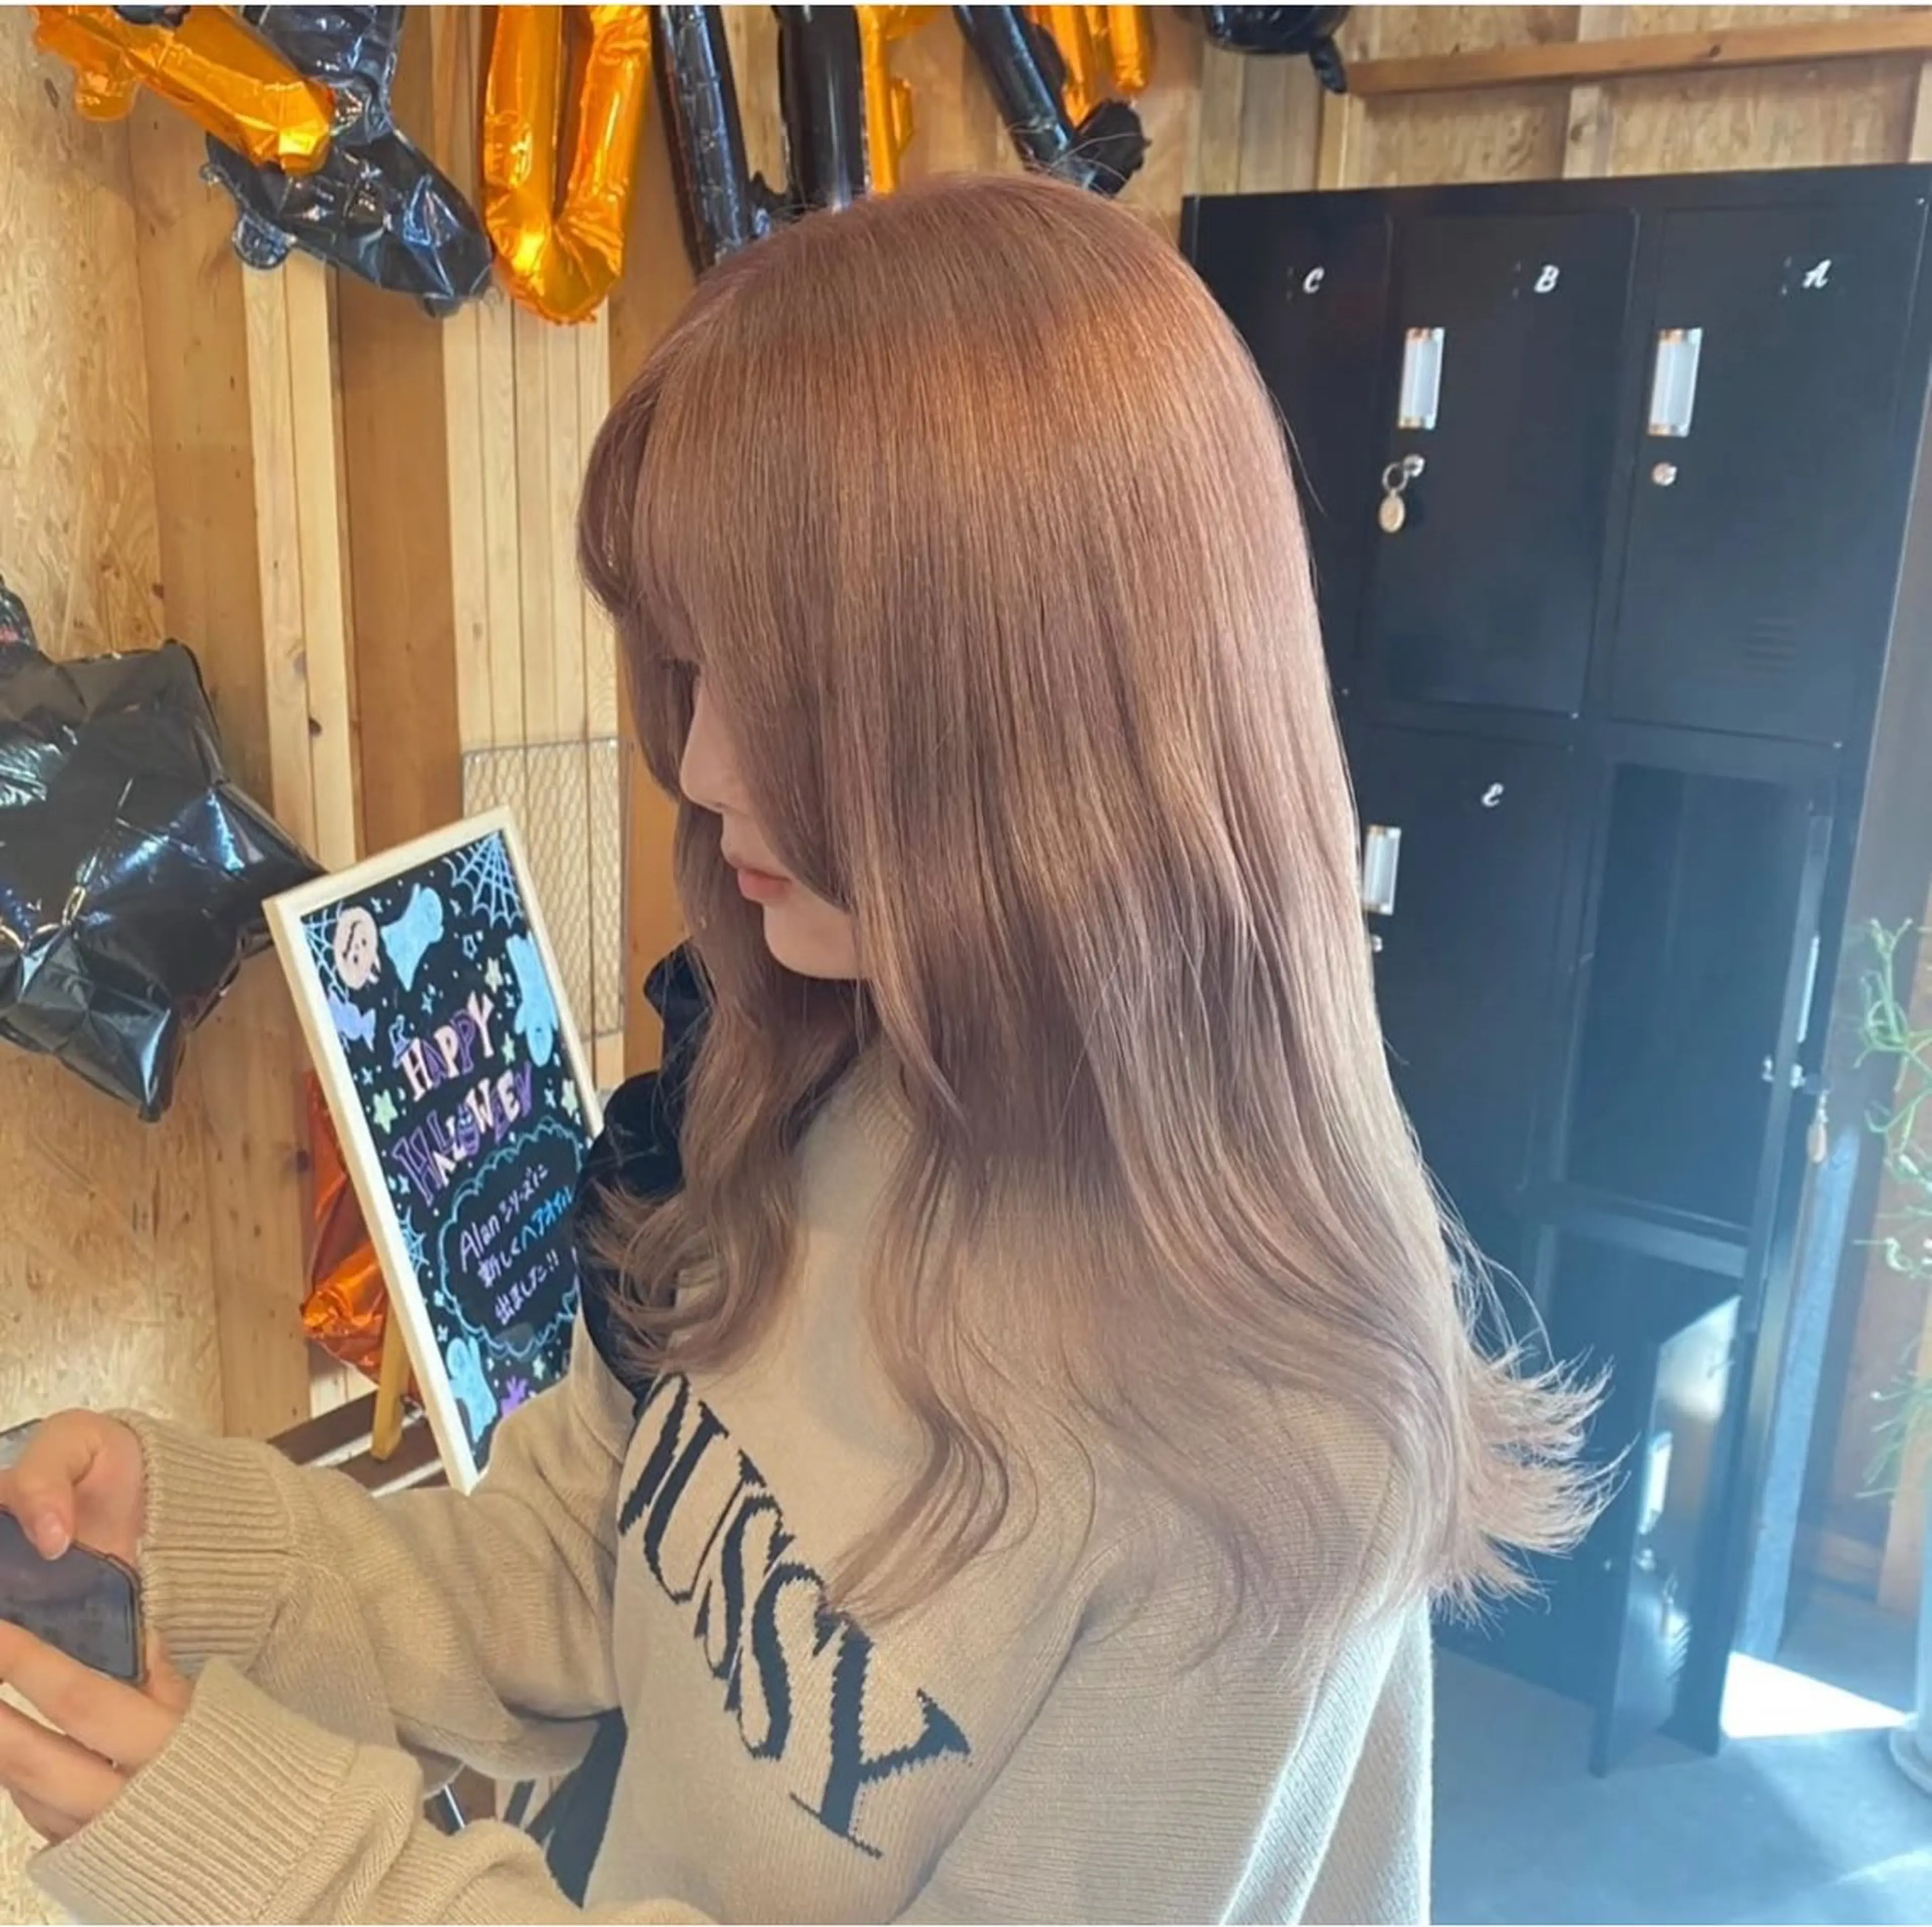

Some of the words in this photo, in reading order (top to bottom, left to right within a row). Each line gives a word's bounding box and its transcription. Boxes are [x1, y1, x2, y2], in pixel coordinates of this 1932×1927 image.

[1303, 268, 1324, 293] C
[1534, 264, 1559, 293] B
[1802, 259, 1831, 288] A
[401, 990, 495, 1101] HAPPY
